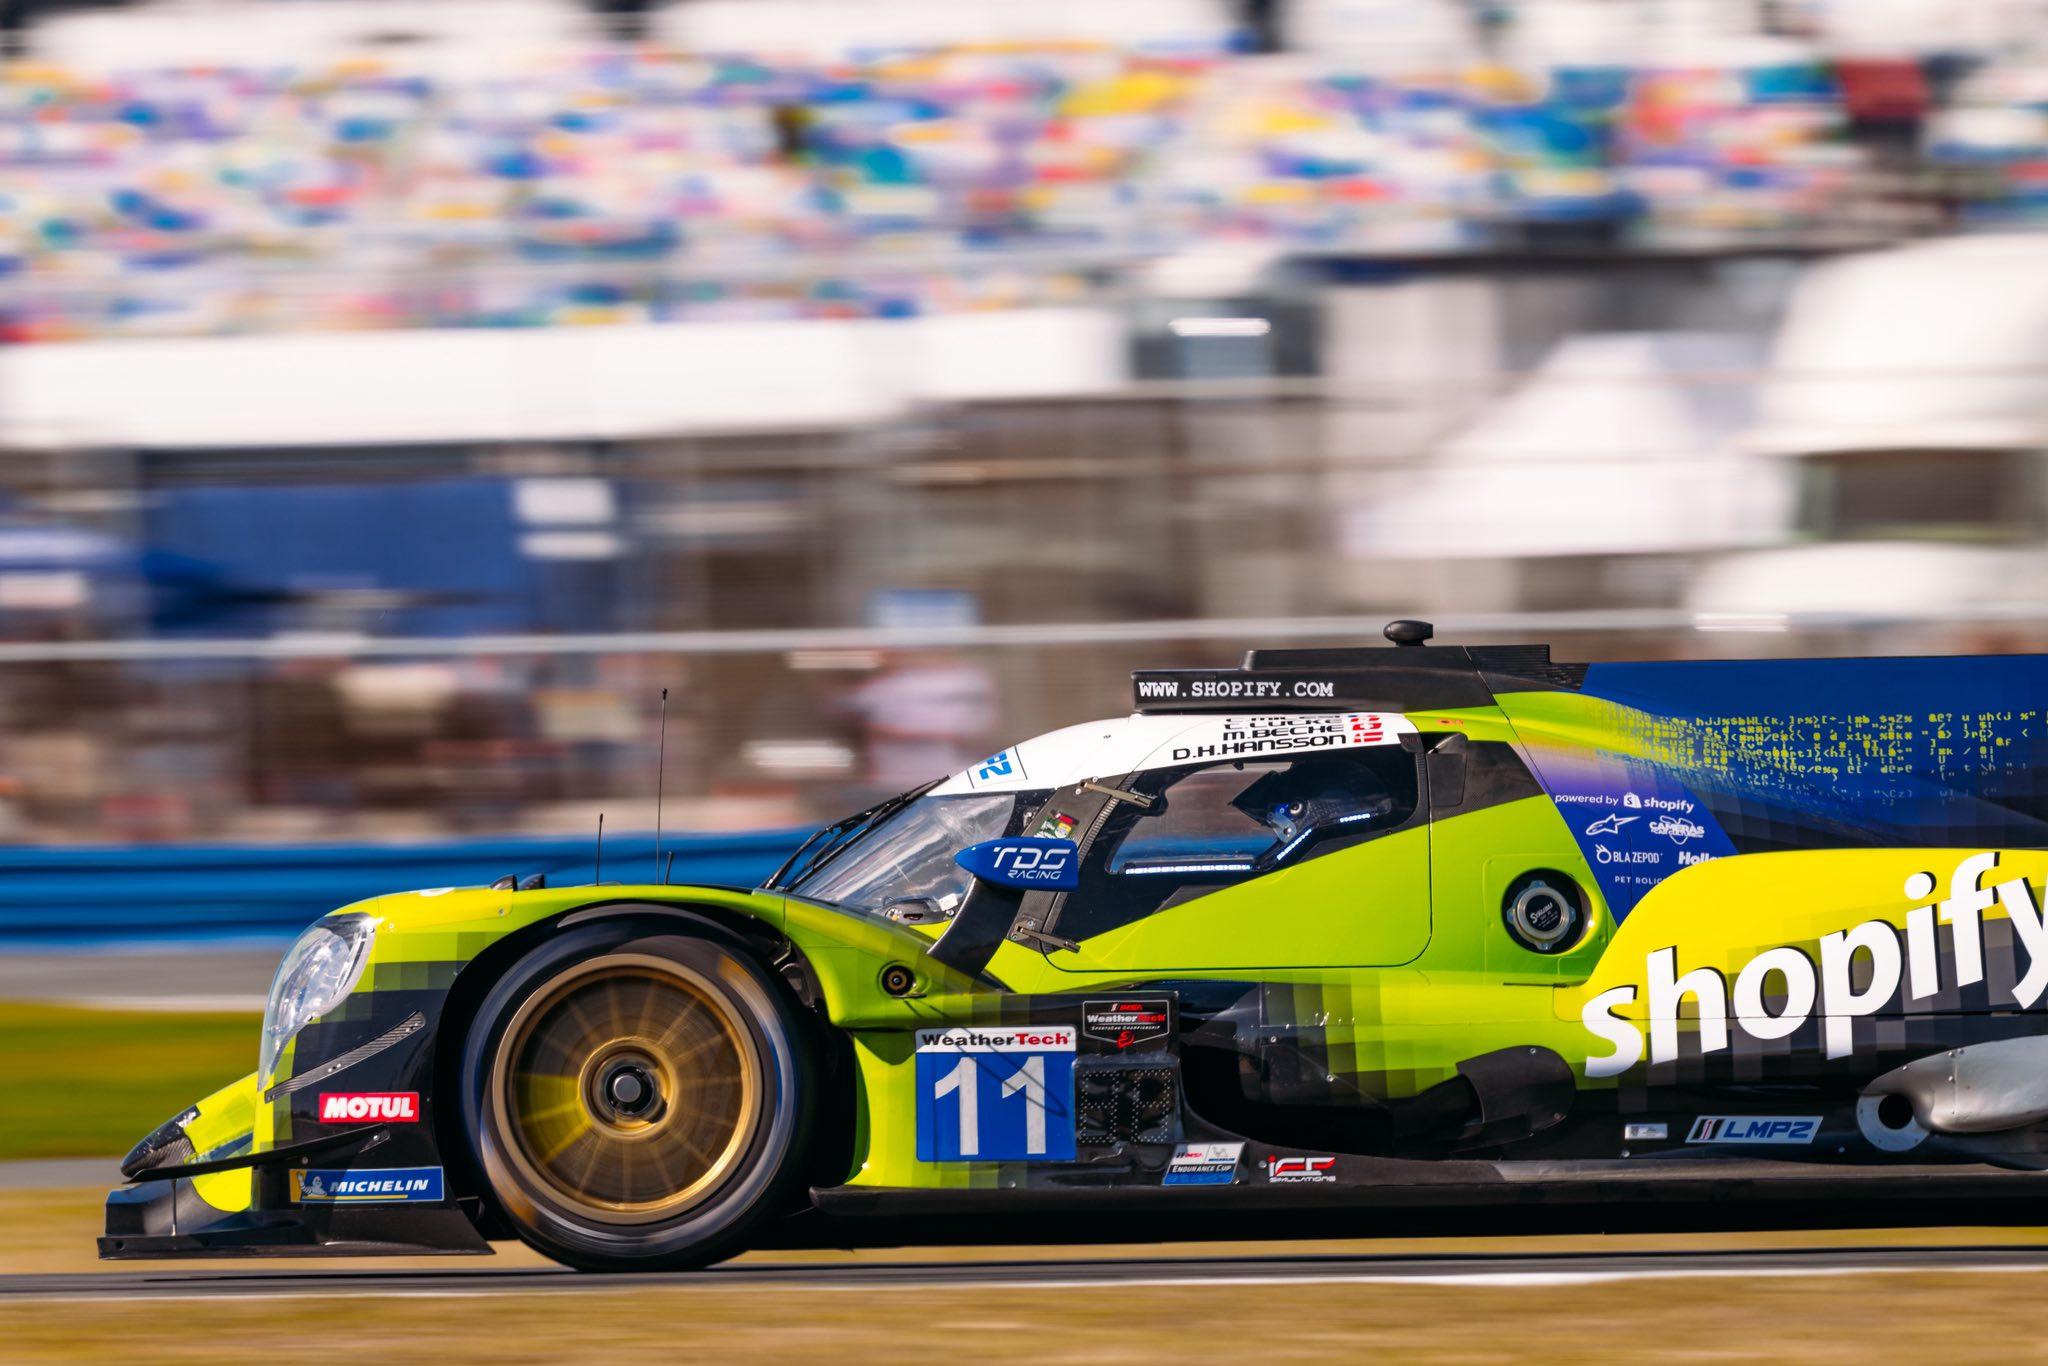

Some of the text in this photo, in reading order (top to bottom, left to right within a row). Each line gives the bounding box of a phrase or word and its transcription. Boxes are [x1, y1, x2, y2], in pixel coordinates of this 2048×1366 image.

[1138, 681, 1334, 697] WWW.SHOPIFY.COM
[1223, 725, 1344, 741] M.BECHE
[1173, 734, 1346, 760] D.H.HANSSON
[1555, 794, 1694, 814] powered by shopify
[1649, 821, 1705, 835] CAMERAS
[993, 846, 1071, 870] TDS
[1007, 869, 1062, 880] RACING
[1582, 852, 2048, 1078] shopify
[1087, 1013, 1166, 1023] WeatherTech
[922, 1032, 1069, 1046] WeatherTech
[323, 1096, 414, 1119] MOTUL
[935, 1056, 1046, 1155] 11
[1723, 1121, 1814, 1138] LMP2
[1216, 1164, 1231, 1172] CUP
[330, 1179, 429, 1193] MICHELIN
